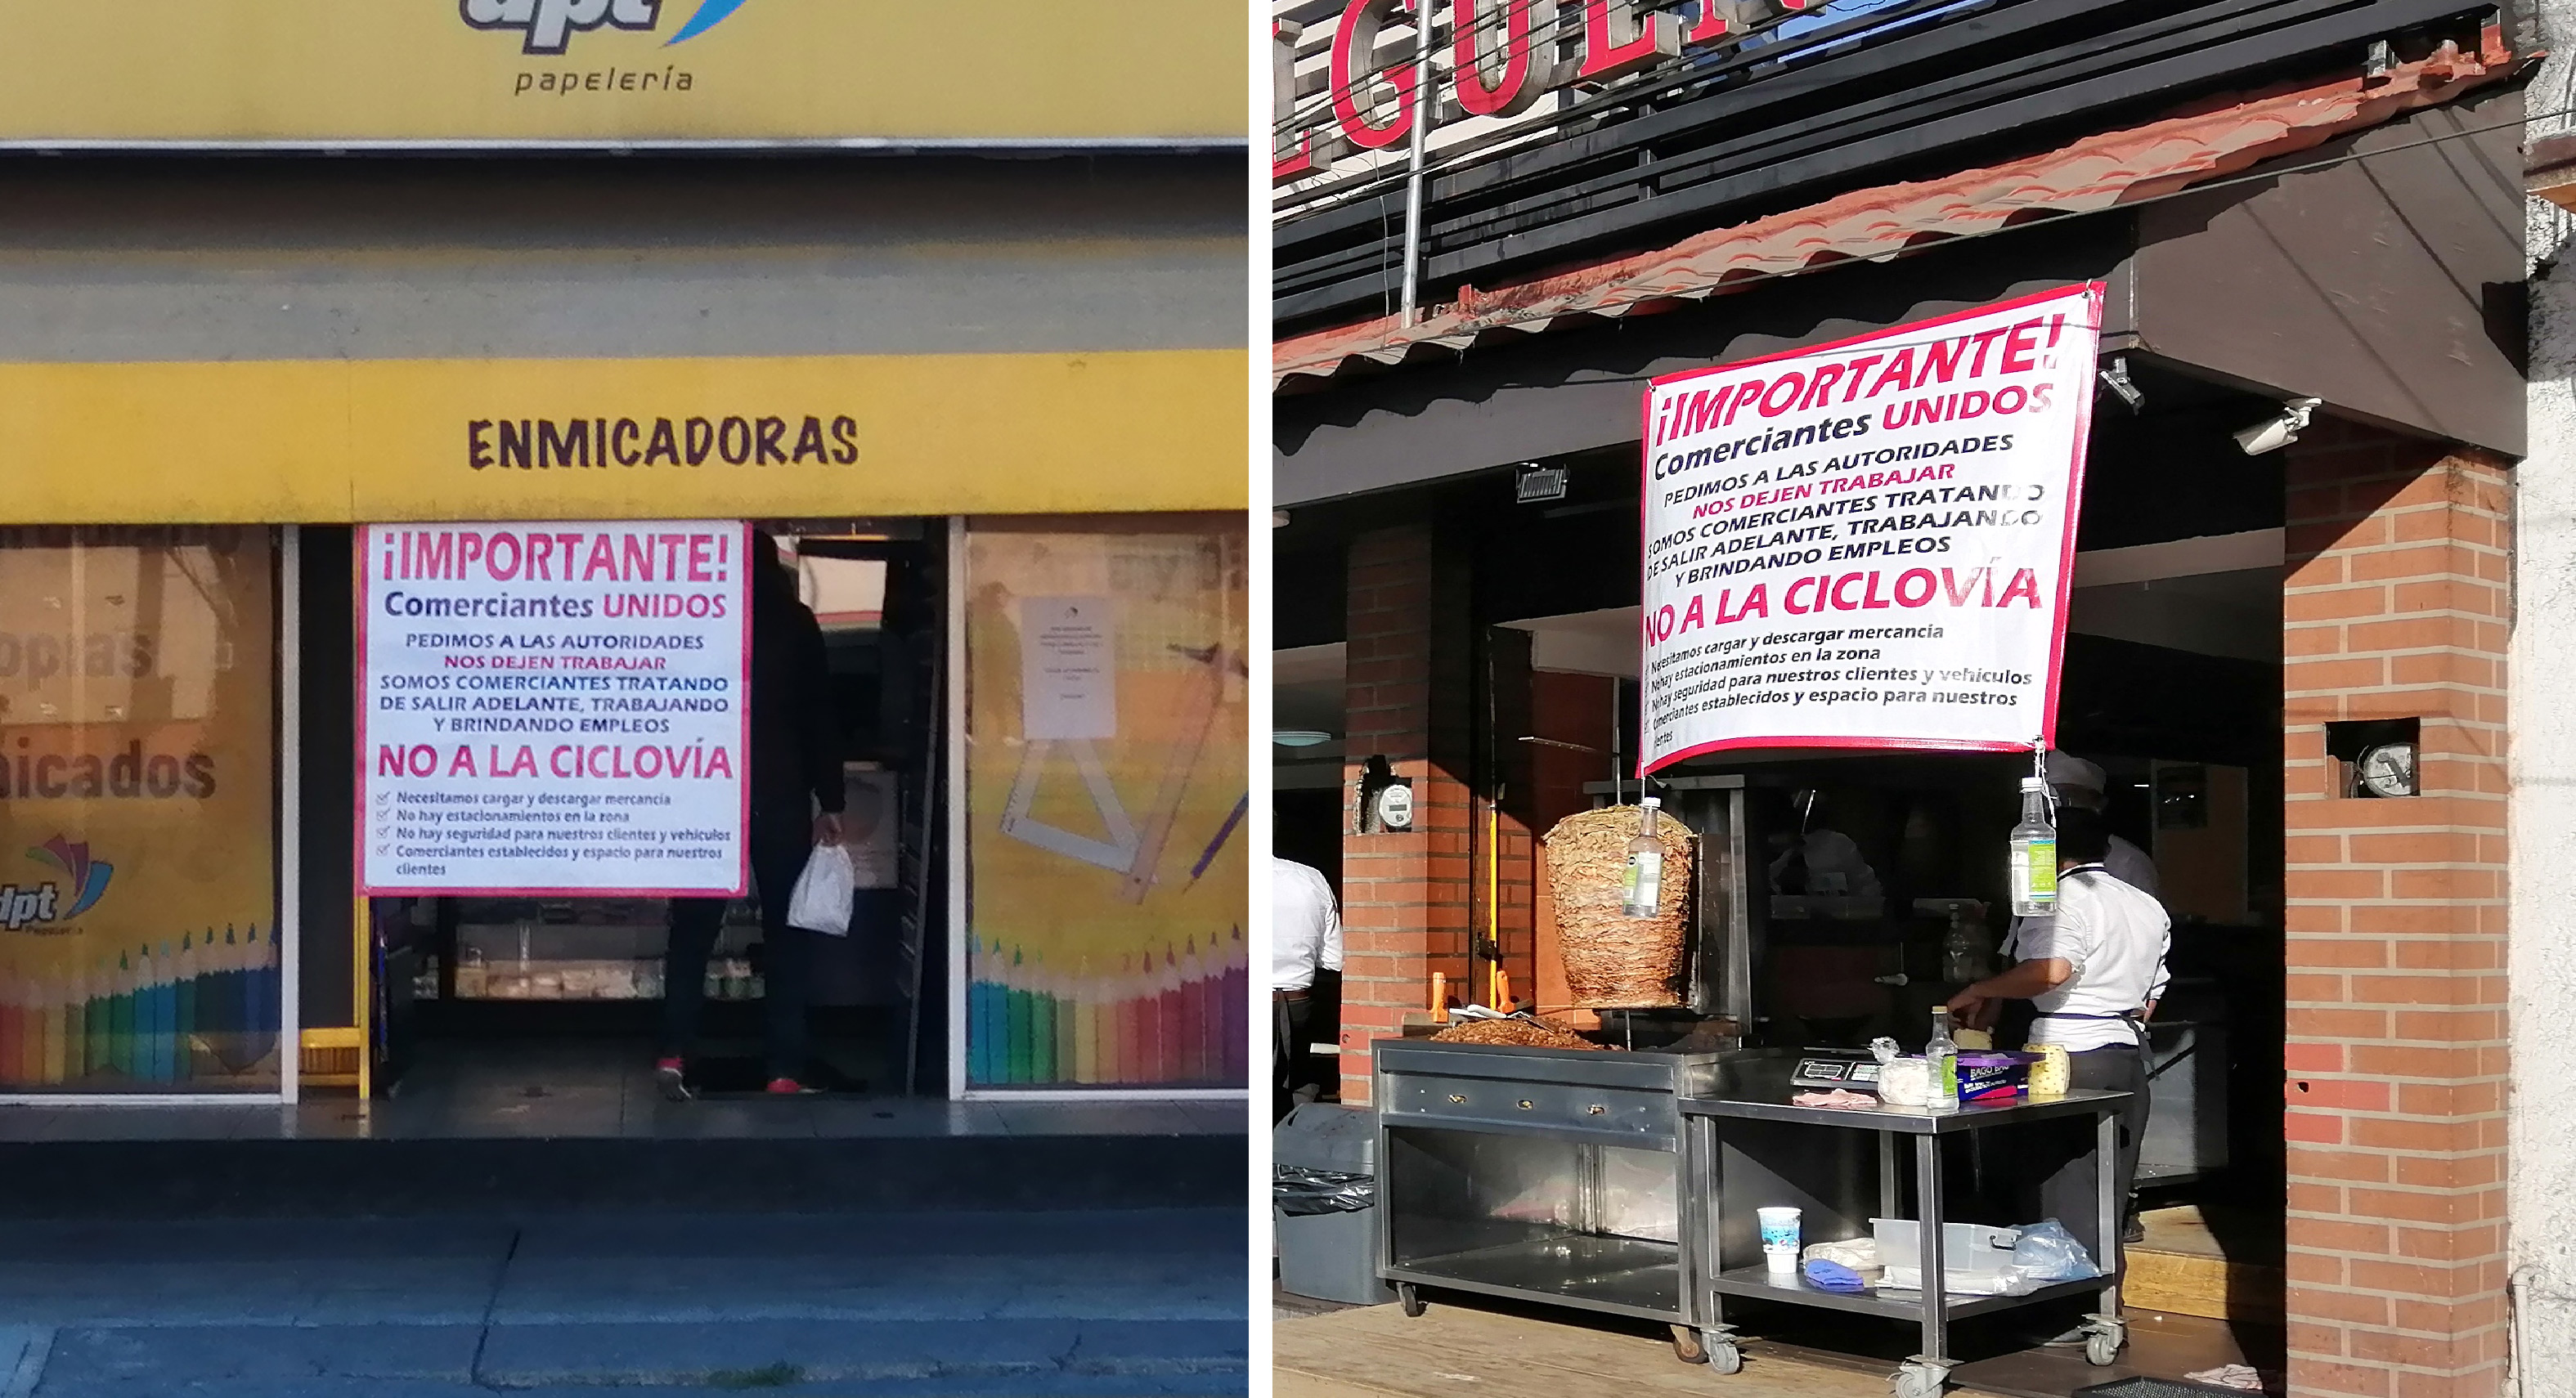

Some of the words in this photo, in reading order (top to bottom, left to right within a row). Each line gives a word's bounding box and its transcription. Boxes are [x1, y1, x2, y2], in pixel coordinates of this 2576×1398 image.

[514, 65, 693, 96] papelería
[1656, 313, 2065, 447] ¡IMPORTANTE!
[468, 415, 859, 471] ENMICADORAS
[1654, 414, 1873, 481] Comerciantes
[1883, 383, 2054, 429] UNIDOS
[1664, 473, 1749, 508] PEDIMOS
[1752, 469, 1769, 486] A
[1775, 460, 1819, 482] LAS
[1822, 434, 2013, 473] AUTORIDADES
[1693, 498, 1735, 519] NOS
[1739, 483, 1813, 509] DEJEN
[1819, 464, 1955, 495] TRABAJAR
[1648, 526, 1696, 558] SOMOS
[1700, 495, 1878, 538] COMERCIANTES
[383, 531, 729, 582] ¡IMPORTANTE!
[1647, 561, 1660, 581] DE
[1661, 546, 1708, 573] SALIR
[1710, 523, 1838, 558] ADELANTE,
[1676, 572, 1686, 588] Y
[1687, 549, 1822, 585] BRINDANDO
[1828, 536, 1951, 562] EMPLEOS
[384, 590, 593, 618] Comerciantes
[604, 594, 727, 618] UNIDOS
[1646, 603, 1674, 647] NO
[1679, 594, 1704, 634] A
[1715, 583, 1769, 625] LA
[1784, 557, 2043, 615] CICLOVÍA
[406, 634, 494, 648] PEDIMOS
[500, 634, 514, 648] A
[520, 634, 555, 648] LAS
[561, 635, 704, 650] AUTORIDADES
[1704, 637, 1747, 656] cargar
[1748, 635, 1760, 652] y
[1762, 630, 1845, 645] descargar
[444, 656, 486, 670] NOS
[491, 656, 554, 670] DEJEN
[560, 656, 667, 670] TRABAJAR
[1660, 673, 1673, 688] hay
[1675, 653, 1787, 682] estacionamientos
[1792, 652, 1811, 662] en
[1816, 648, 1832, 661] la
[1836, 648, 1881, 661] zona
[379, 675, 450, 690] SOMOS
[456, 676, 611, 691] COMERCIANTES
[617, 677, 729, 692] TRATANDO
[1673, 676, 1726, 701] seguridad
[1728, 673, 1761, 692] para
[1766, 669, 1841, 683] nuestros
[1846, 667, 1918, 681] clientes
[1921, 670, 1934, 685] y
[380, 697, 406, 710] DE
[411, 697, 466, 711] SALIR
[472, 697, 584, 713] ADELANTE,
[591, 698, 729, 712] TRABAJANDO
[1702, 690, 1789, 711] establecidos
[1793, 691, 1805, 706] y
[1809, 688, 1878, 706] espacio
[1883, 690, 1927, 706] para
[1932, 691, 2017, 706] nuestros
[433, 719, 444, 733] Y
[451, 719, 573, 733] BRINDANDO
[580, 719, 670, 733] EMPLEOS
[378, 744, 438, 777] NO
[448, 745, 477, 777] A
[490, 745, 538, 777] LA
[549, 737, 733, 778] CICLOVÍA
[397, 791, 479, 805] Necesitamos
[482, 793, 524, 808] cargar
[527, 795, 535, 807] y
[538, 791, 602, 808] descargar
[397, 809, 415, 822] No
[419, 809, 443, 825] hay
[446, 809, 562, 823] estacionamientos
[565, 812, 582, 823] en
[585, 809, 597, 823] la
[599, 812, 630, 823] zona
[397, 827, 415, 840] No
[419, 827, 443, 842] hay
[447, 827, 511, 843] seguridad
[514, 830, 544, 842] para
[547, 829, 604, 841] nuestros
[608, 827, 656, 841] clientes
[658, 831, 667, 843] y
[396, 845, 484, 859] Comerciantes
[487, 845, 569, 859] establecidos
[572, 848, 579, 861] y
[582, 845, 631, 861] espacio
[634, 849, 664, 861] para
[666, 847, 723, 859] nuestros
[396, 863, 447, 876] clientes
